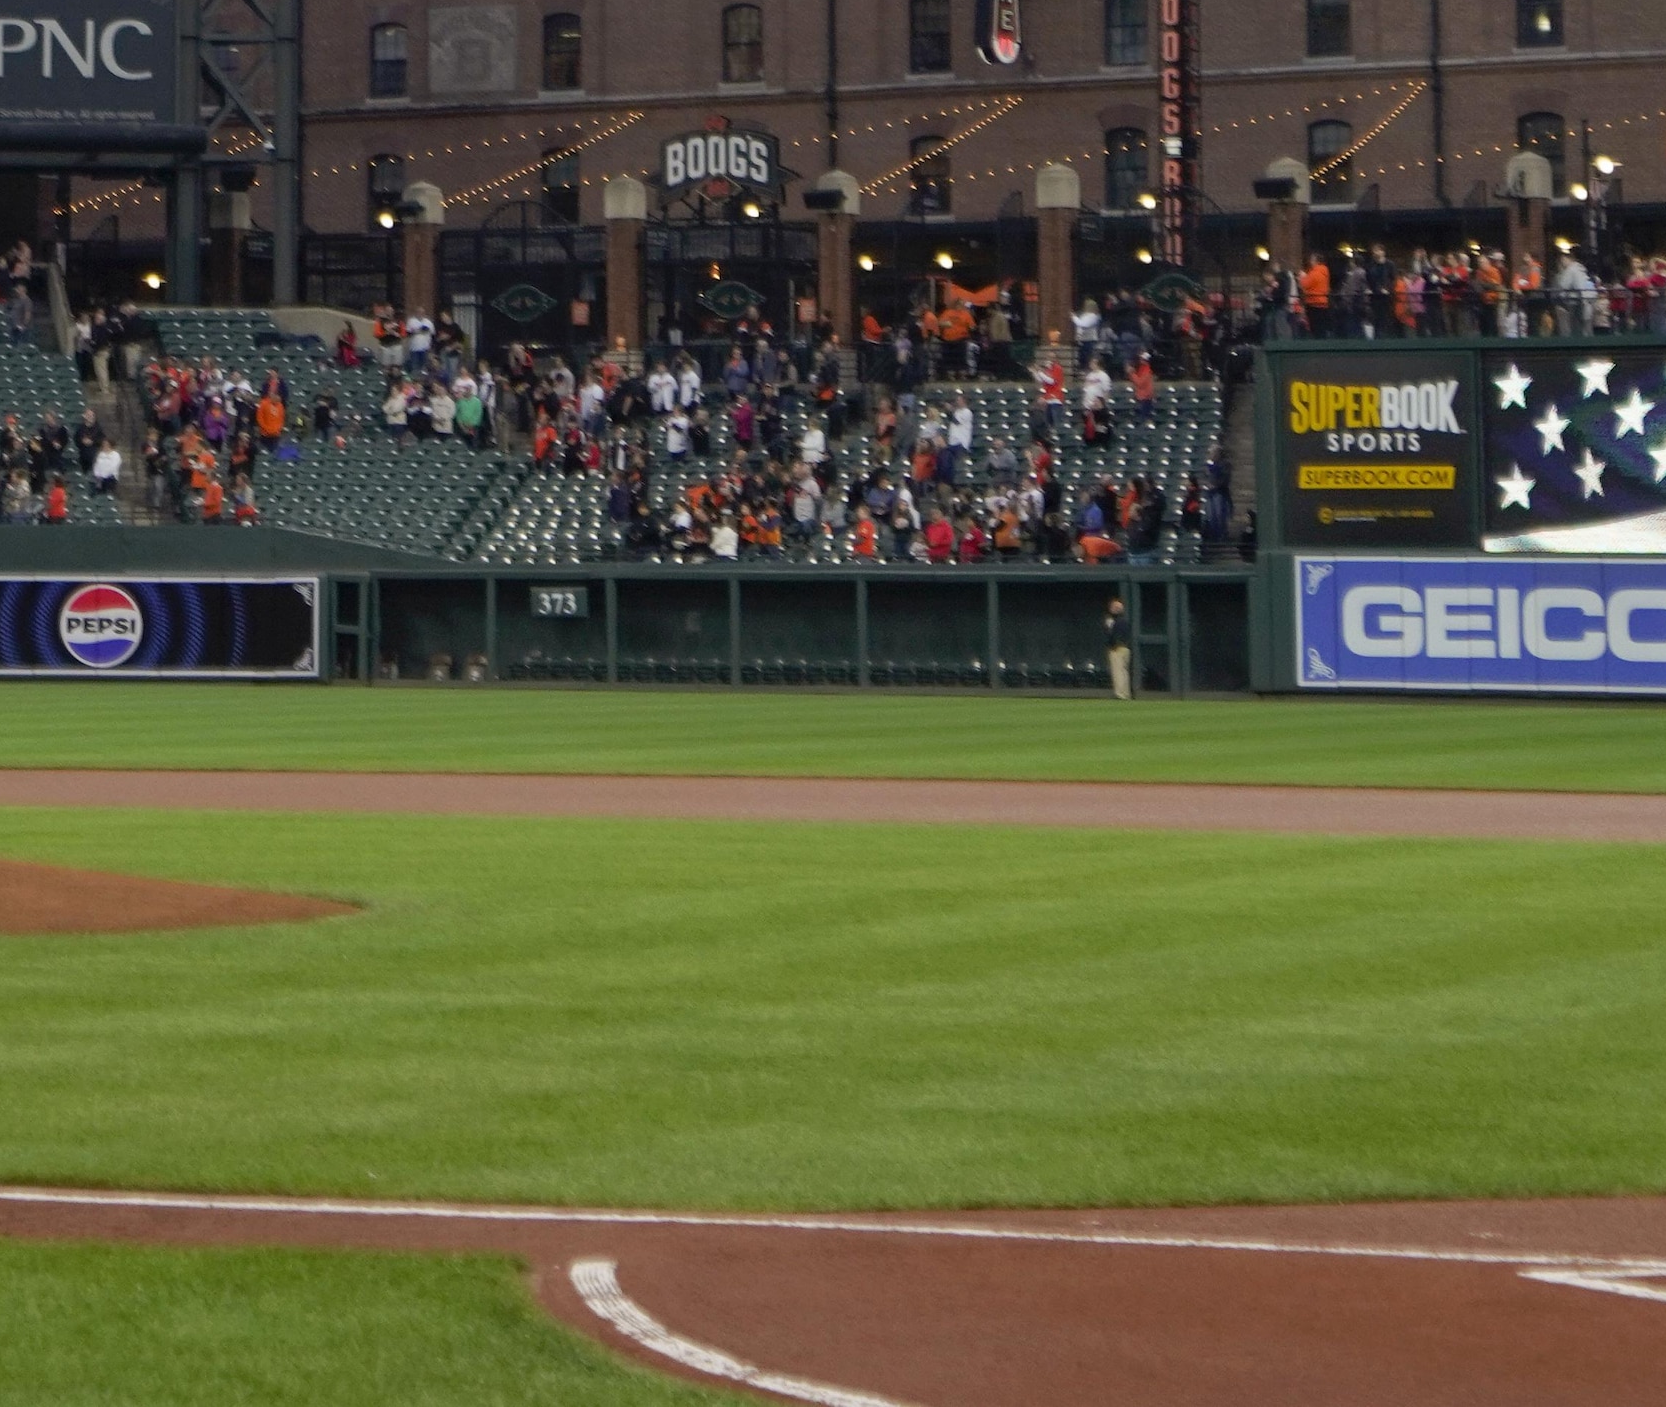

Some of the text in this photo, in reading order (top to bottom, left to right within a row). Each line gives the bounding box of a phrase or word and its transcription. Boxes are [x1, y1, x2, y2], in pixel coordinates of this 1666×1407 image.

[666, 135, 769, 187] BOOG'S
[1290, 380, 1461, 434] SUPERBOOK
[1327, 432, 1421, 452] SPORTS
[1304, 469, 1450, 485] SUPERBOOK.COM
[538, 592, 578, 615] 373
[66, 617, 136, 635] PEPSI
